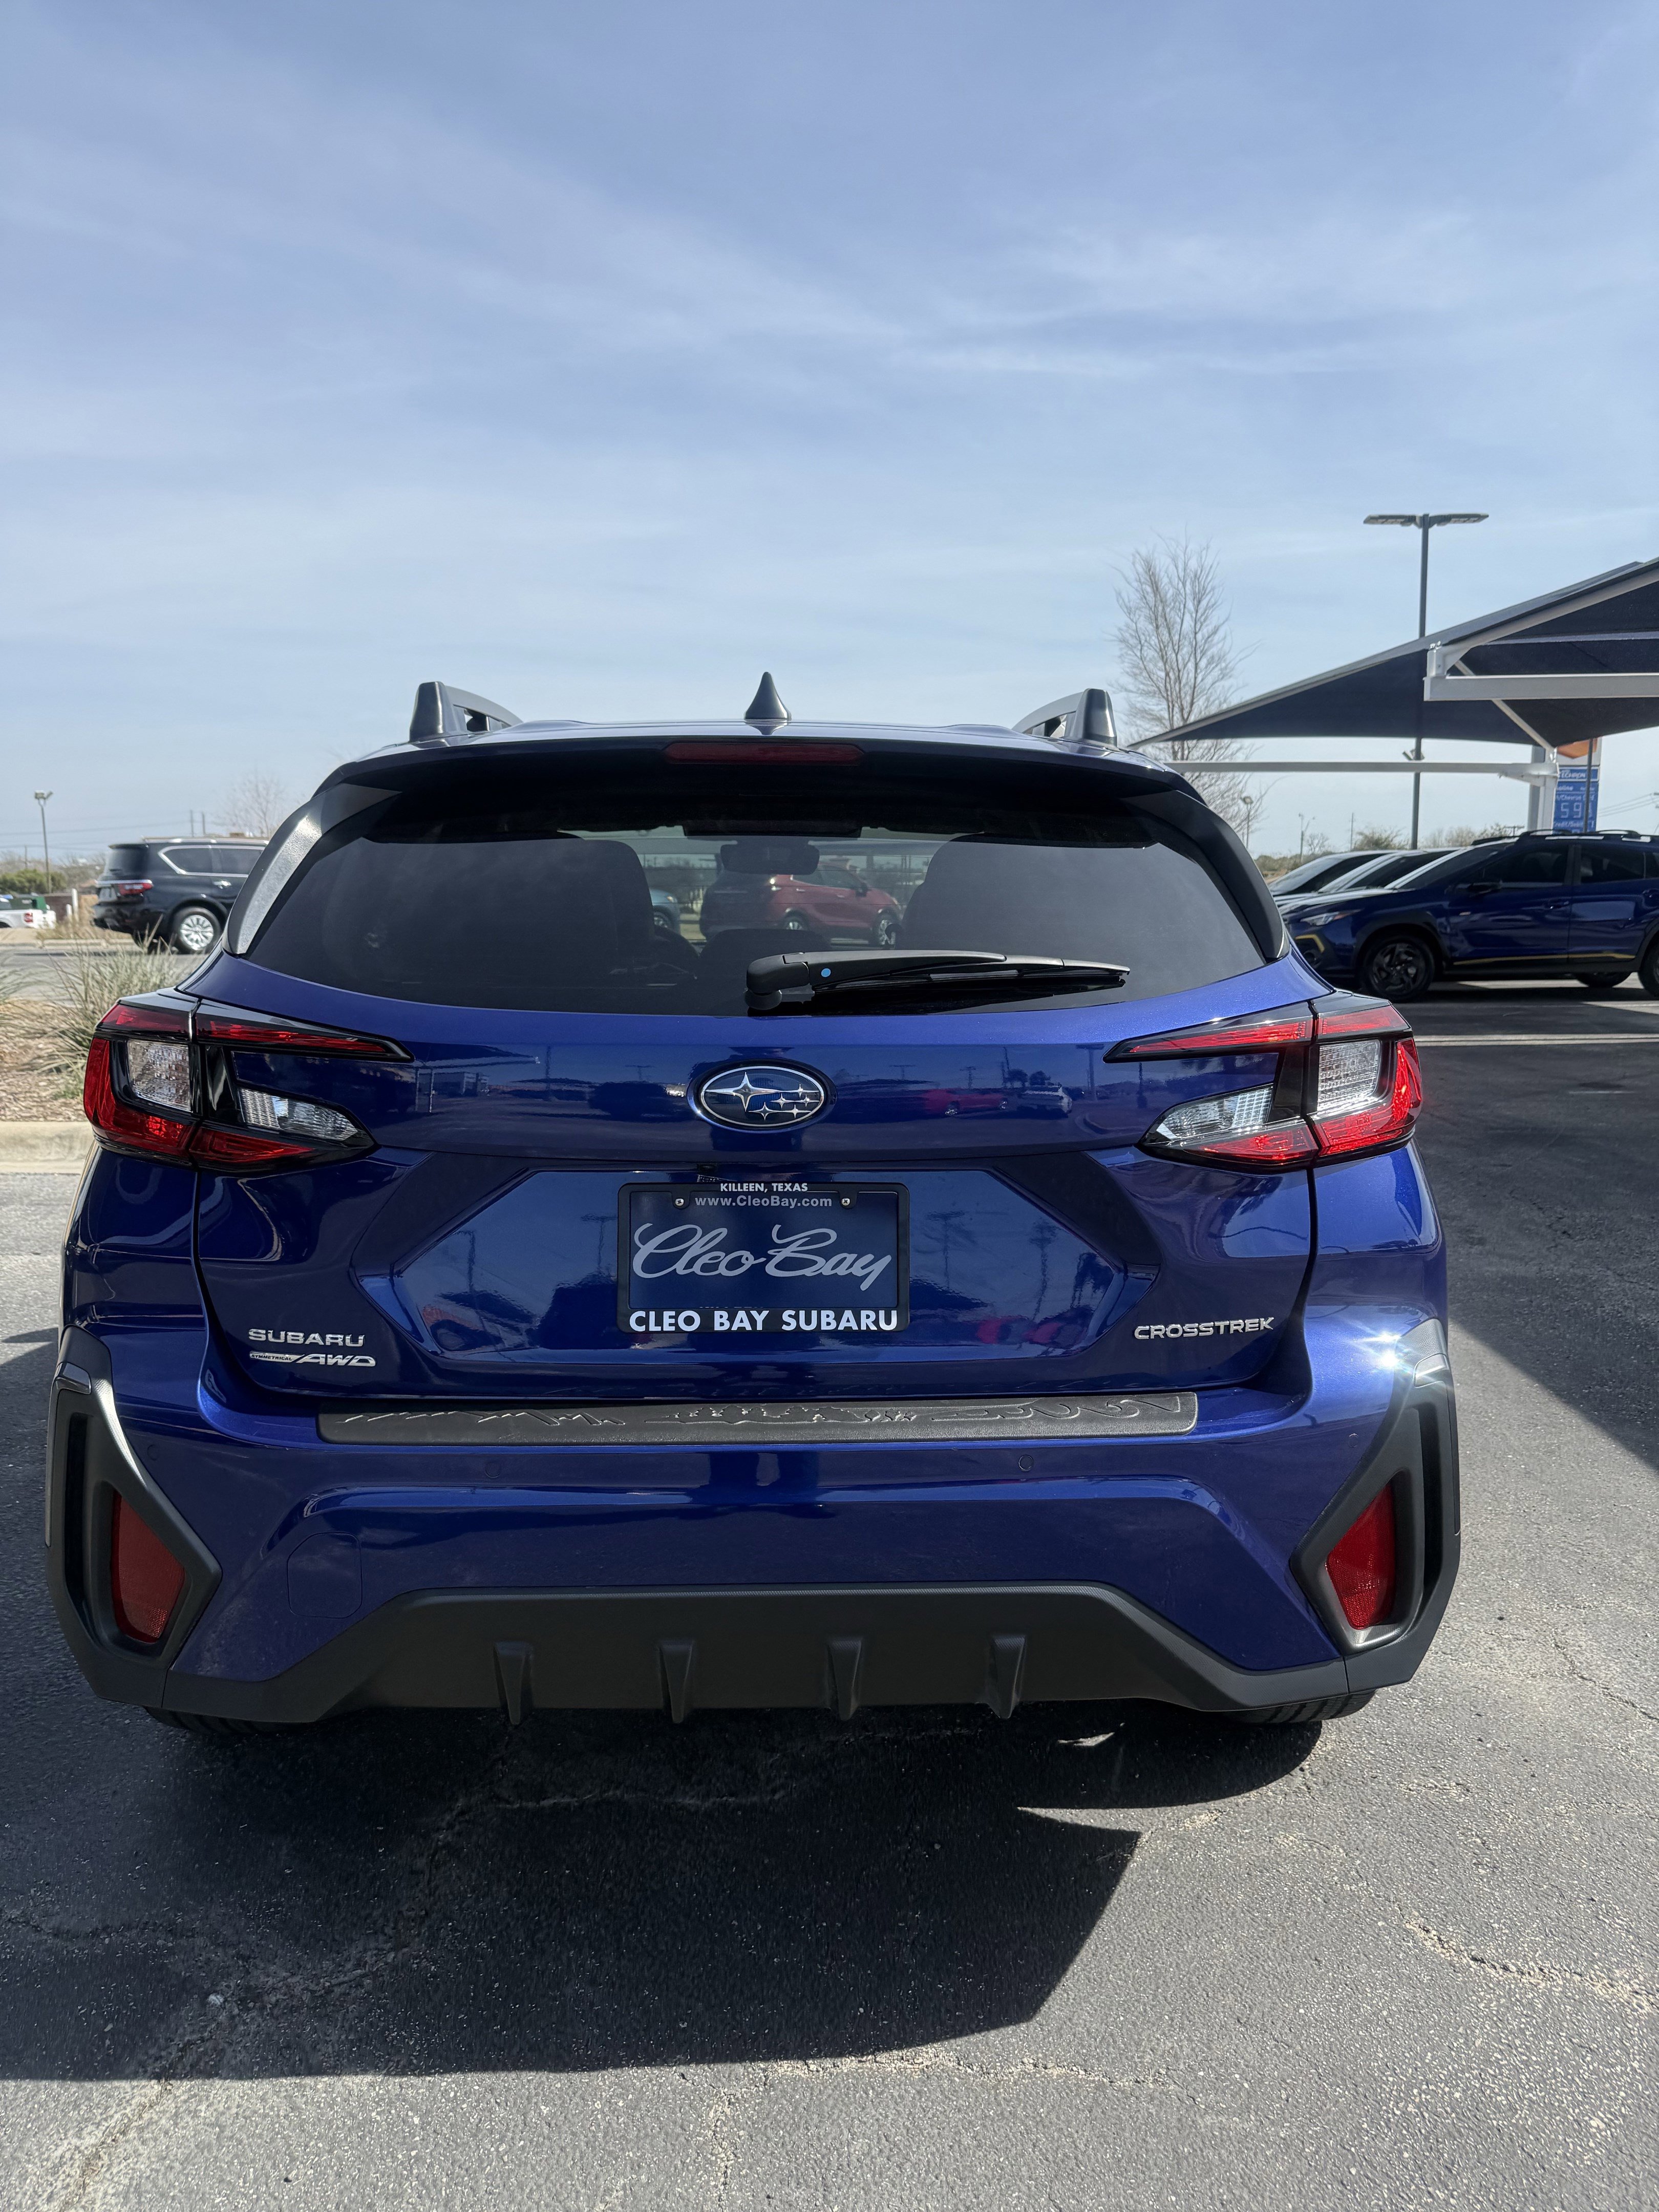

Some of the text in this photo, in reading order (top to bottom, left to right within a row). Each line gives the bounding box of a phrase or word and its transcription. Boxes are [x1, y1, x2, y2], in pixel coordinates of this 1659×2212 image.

[720, 1183, 808, 1193] KILLEEN, TEXAS
[695, 1195, 832, 1208] www.CleoBay.com
[632, 1223, 892, 1291] Cleo Bay
[629, 1310, 898, 1332] CLEO BAY SUBARU
[1134, 1317, 1274, 1339] CROSSTREK
[248, 1329, 365, 1347] SUBARU
[296, 1354, 376, 1367] AWD
